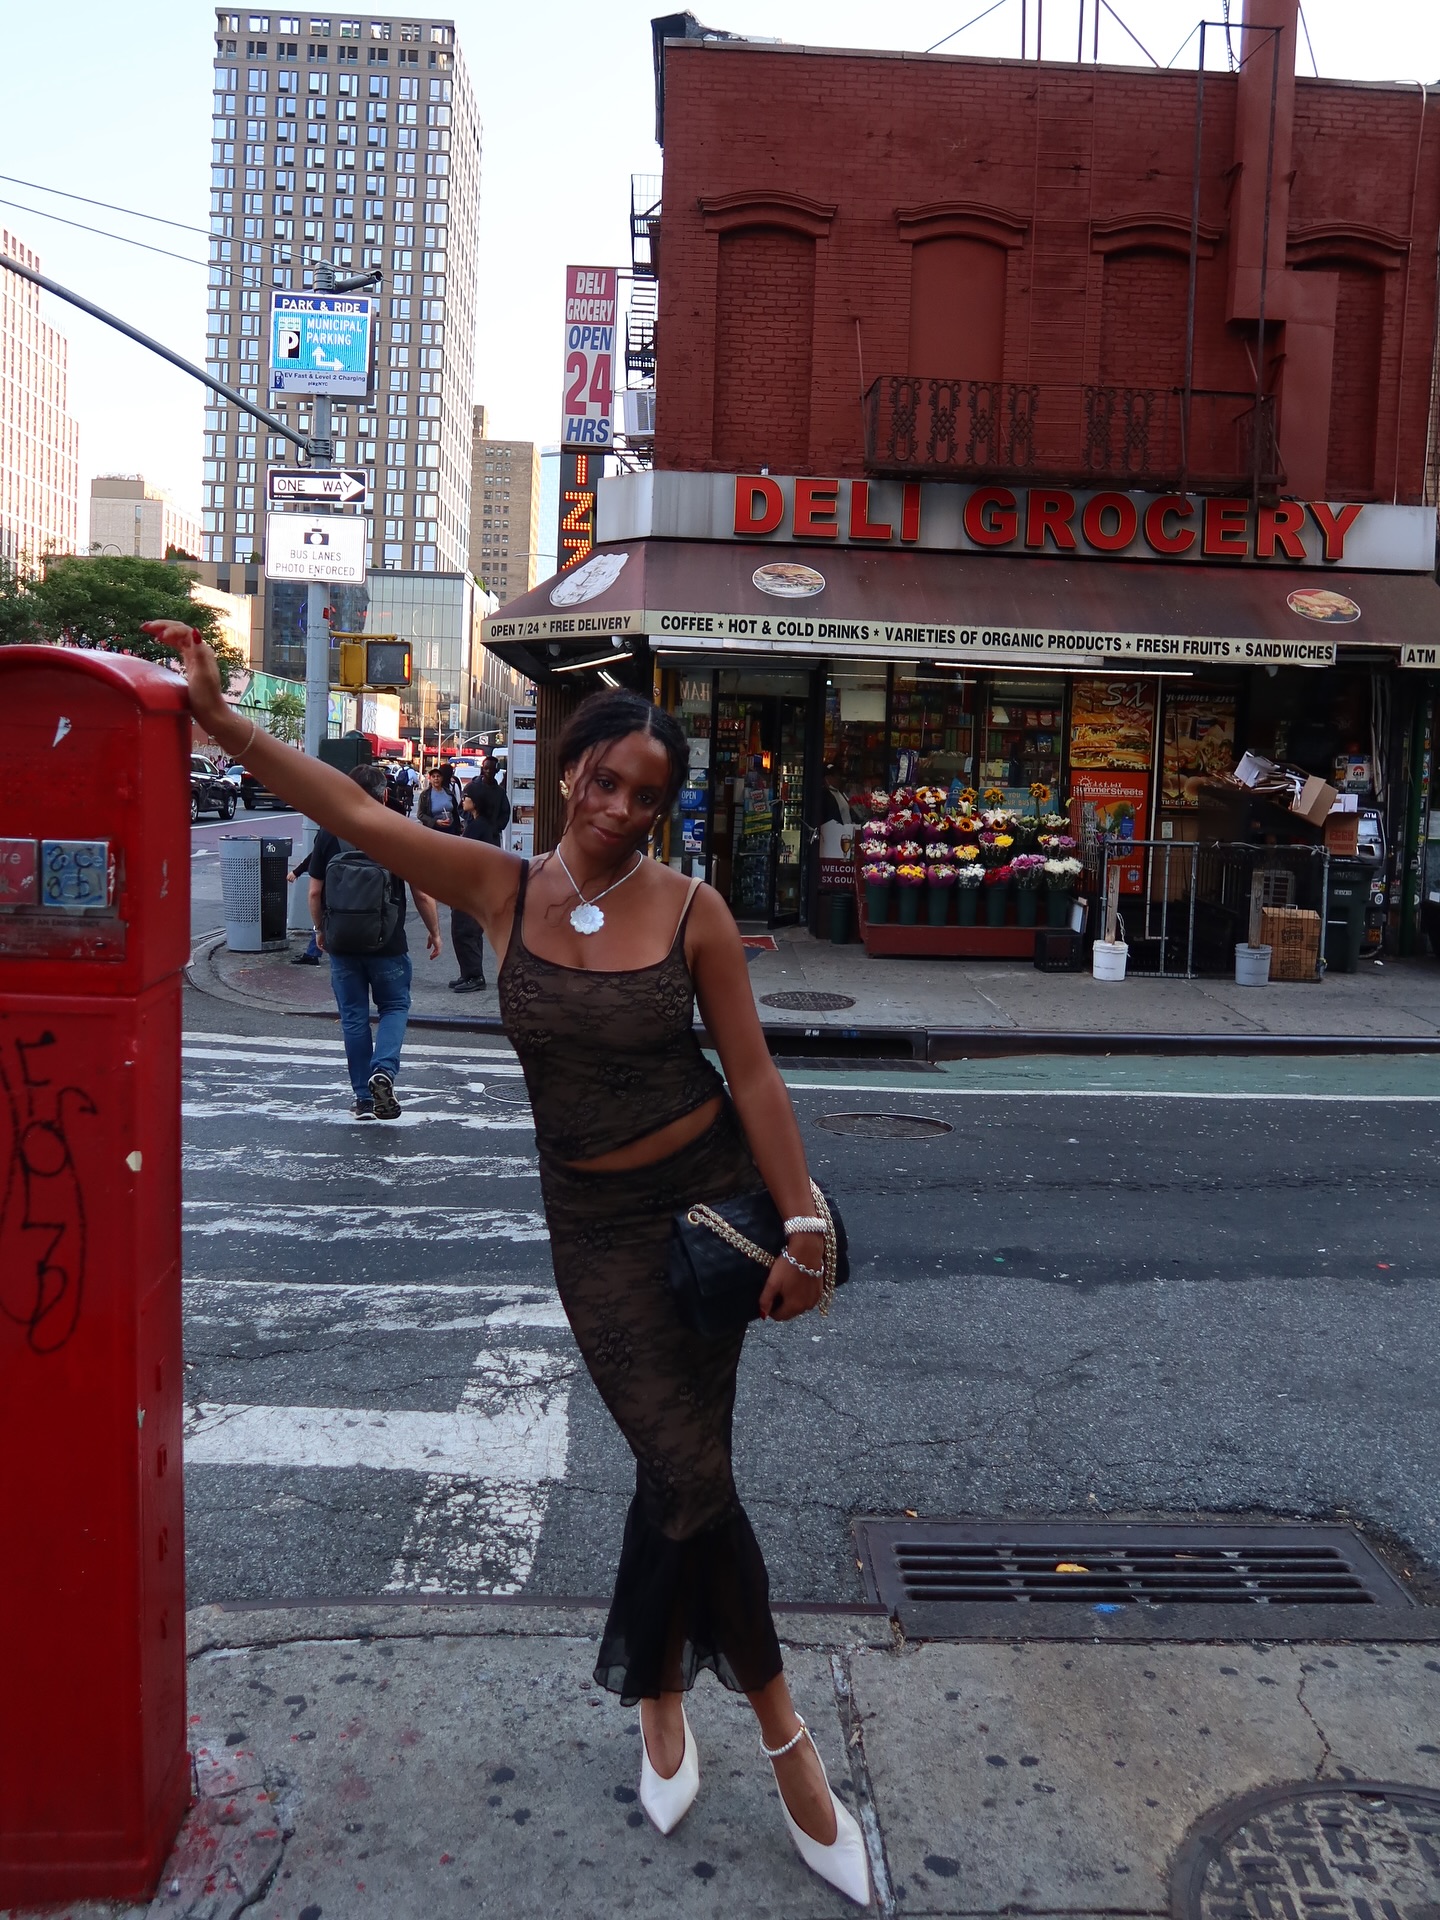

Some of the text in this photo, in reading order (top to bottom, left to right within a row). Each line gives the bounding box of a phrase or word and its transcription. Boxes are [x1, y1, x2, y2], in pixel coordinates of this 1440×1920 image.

[575, 271, 606, 295] DELI
[282, 299, 360, 313] PARK & RIDE
[566, 298, 614, 322] GROCERY
[307, 318, 362, 332] MUNICIPAL
[306, 332, 351, 345] PARKING
[568, 325, 612, 350] OPEN
[565, 351, 612, 416] 24
[566, 417, 610, 443] HRS
[277, 479, 353, 493] ONE WAY
[734, 475, 1364, 561] DELI GROCERY
[290, 549, 342, 561] BUS LANES
[275, 563, 355, 576] PHOTO ENFORCED
[490, 616, 631, 637] OPEN 7/24 FREE DELIVERY
[661, 615, 1333, 660] COFFEE HOT & COLD DRINKS VARIETIES OF ORGANIC PRODUCTS FRESH FRUITS SANDWICHES
[1407, 649, 1436, 663] ATM
[1102, 682, 1149, 708] SX
[681, 790, 697, 800] OPEN
[821, 875, 855, 884] SX GOU
